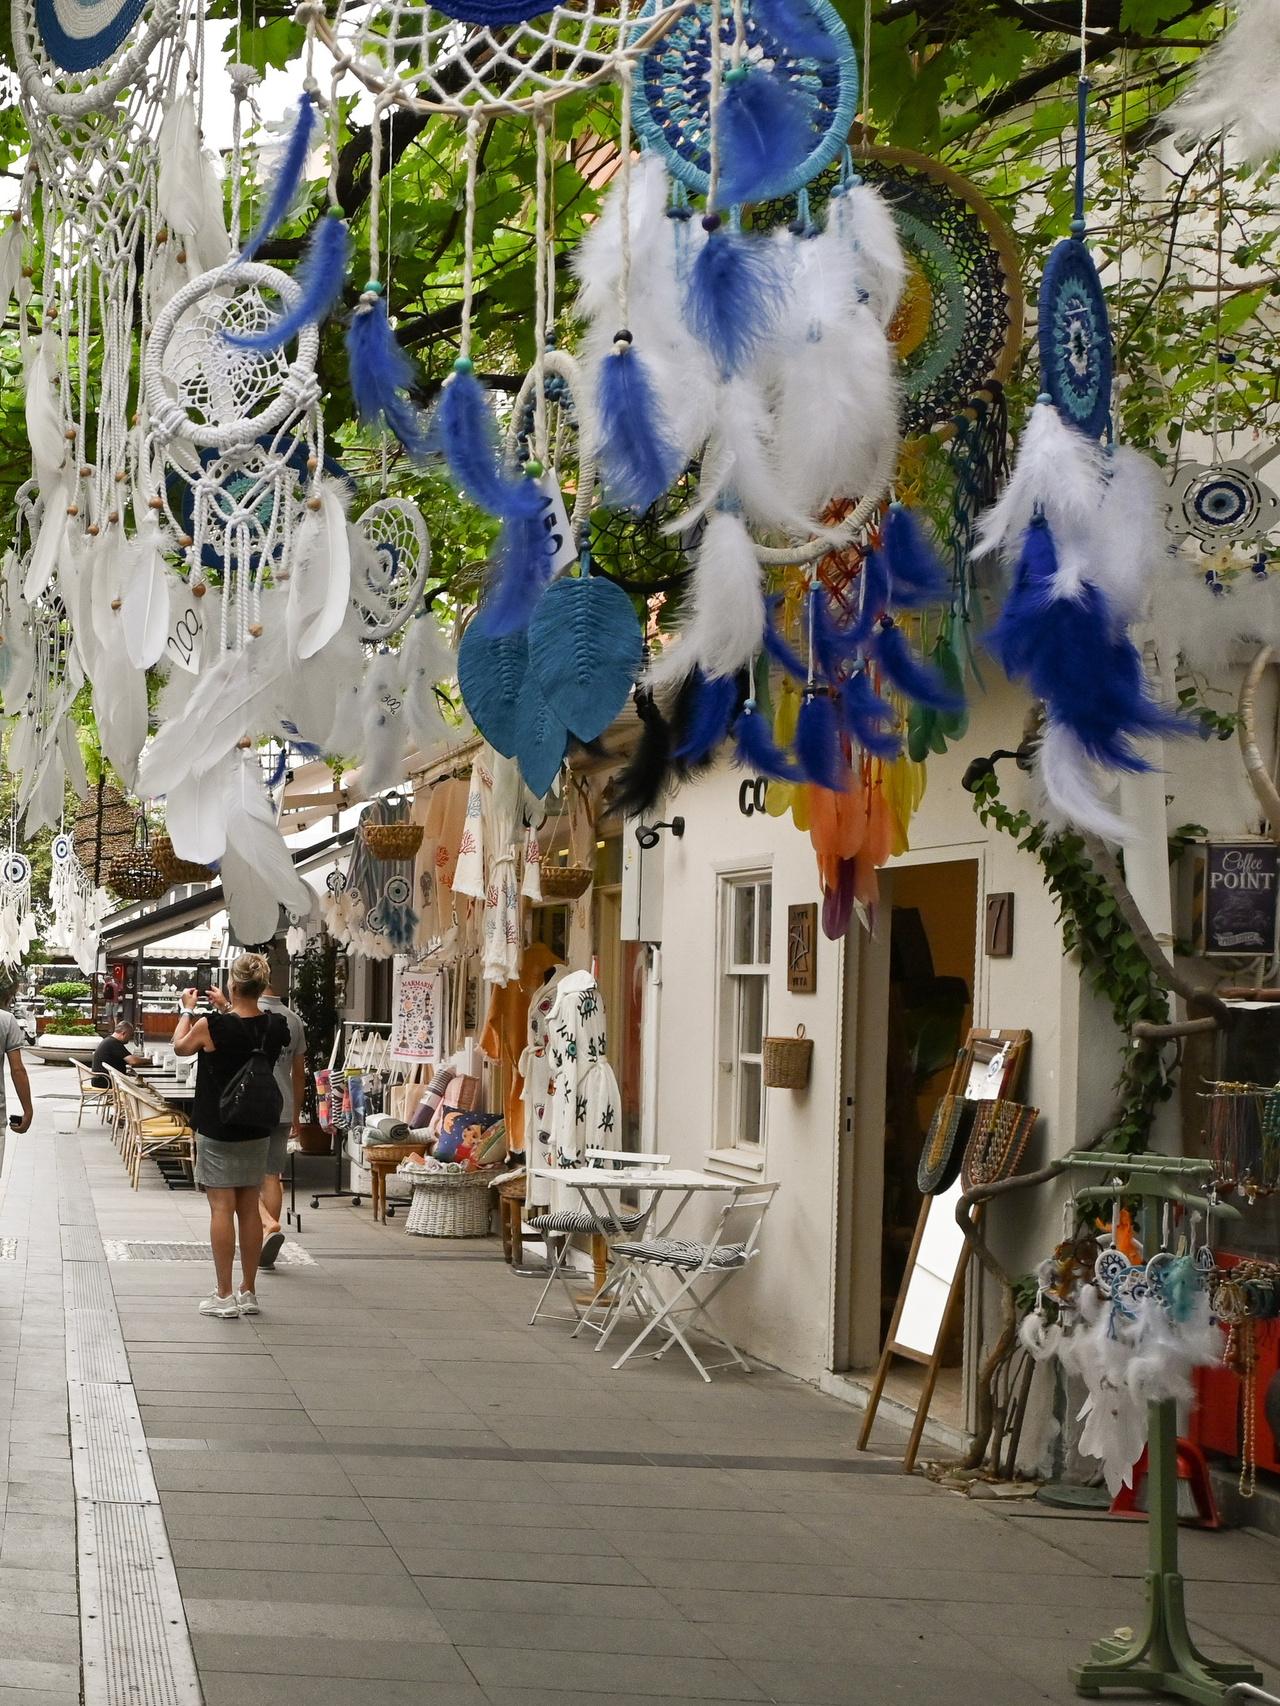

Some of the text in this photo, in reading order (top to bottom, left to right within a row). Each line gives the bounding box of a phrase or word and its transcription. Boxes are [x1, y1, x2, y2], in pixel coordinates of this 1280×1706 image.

[381, 694, 401, 710] 300
[1222, 851, 1263, 873] Coffee
[1210, 872, 1275, 889] POINT
[988, 899, 1005, 950] 7
[402, 981, 433, 990] MARMARIS
